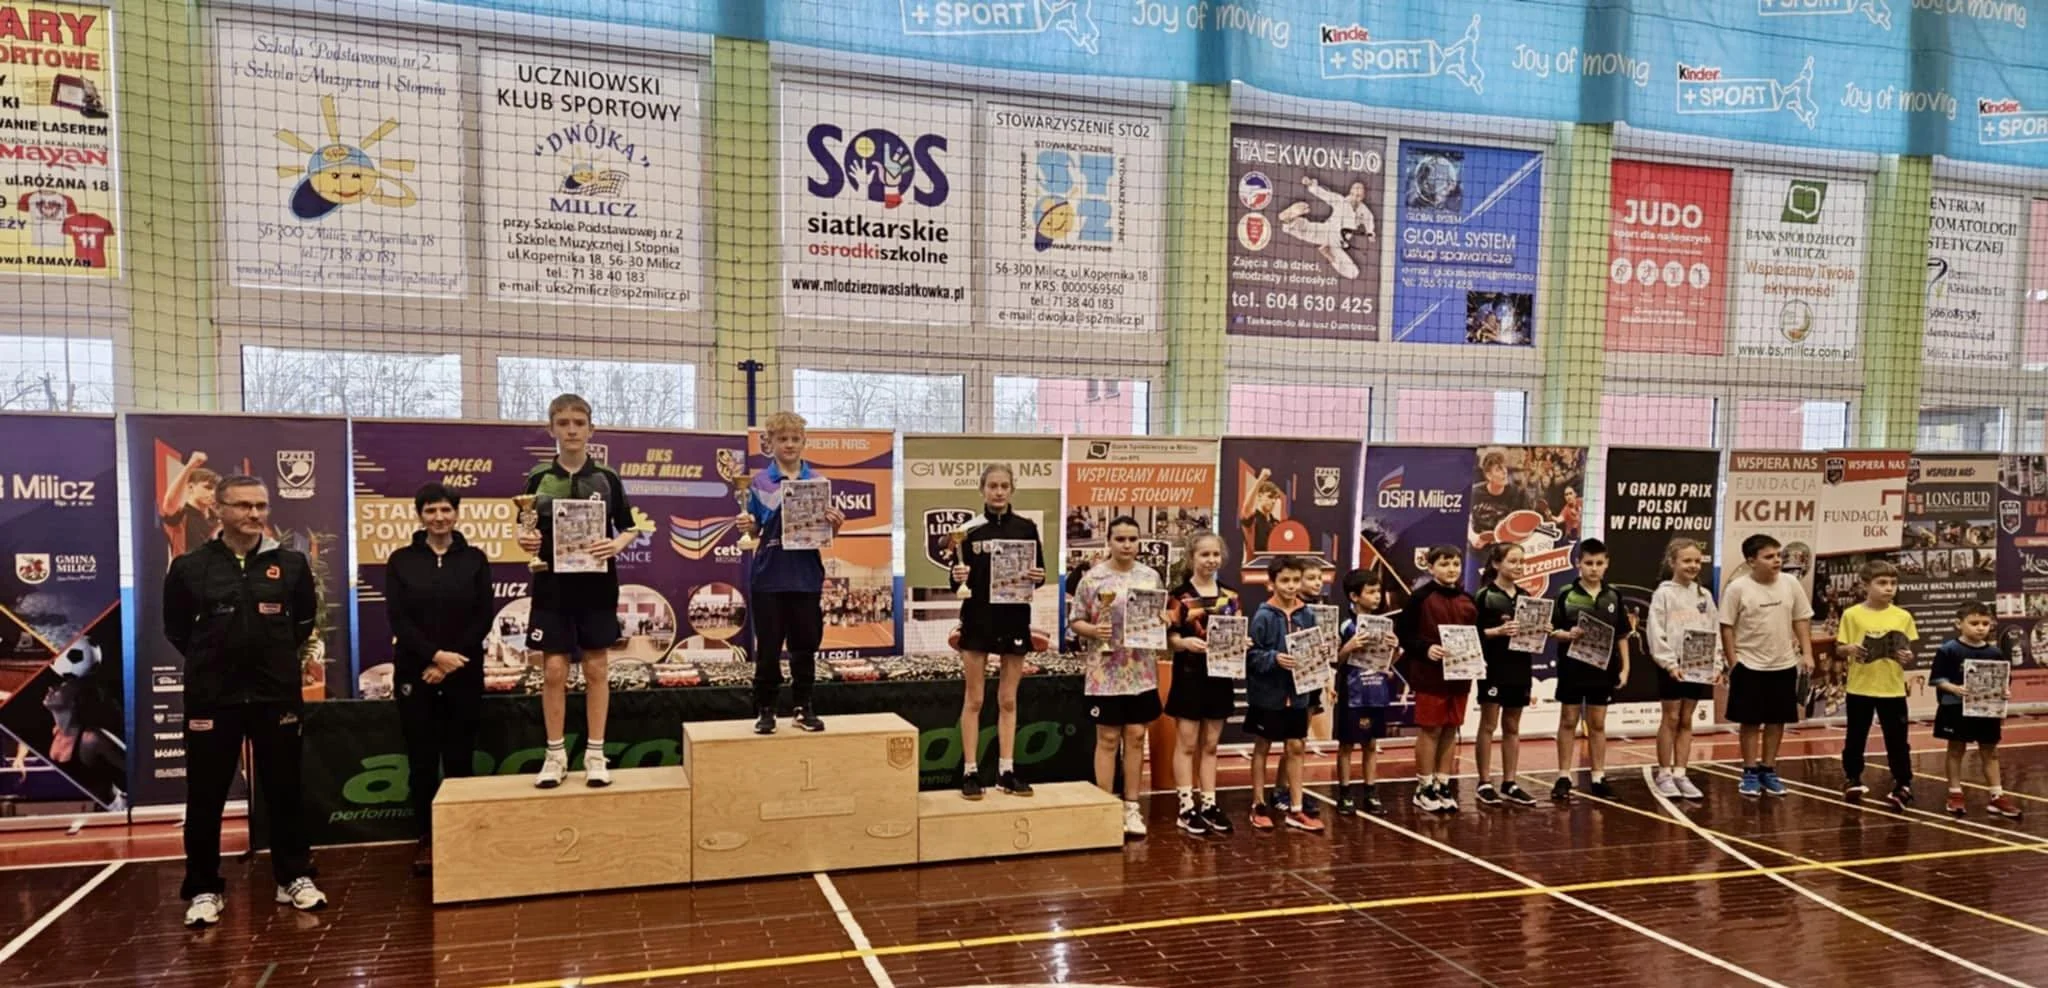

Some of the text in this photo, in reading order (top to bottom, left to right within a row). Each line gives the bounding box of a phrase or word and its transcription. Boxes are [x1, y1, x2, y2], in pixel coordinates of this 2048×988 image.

[935, 2, 1026, 27] SPORT
[1132, 1, 1290, 48] Joy of moving
[309, 40, 399, 68] Podstawowa
[1352, 47, 1424, 71] SPORT
[1511, 44, 1550, 78] Joy
[1555, 46, 1578, 73] of
[517, 64, 662, 96] UCZNIOWSKI
[496, 88, 682, 122] KLUB SPORTOWY
[1698, 86, 1767, 106] SPORT
[1840, 81, 1958, 121] Joy of moving
[43, 121, 108, 137] LASEREM
[995, 112, 1115, 137] STOWARZYSZENIE
[1033, 141, 1114, 154] STOWARZYSZENIE
[1232, 137, 1381, 173] TAEKWON-DO
[806, 123, 950, 208] SOS
[92, 181, 110, 195] 18
[549, 197, 638, 218] MILICZ
[1623, 198, 1704, 230] JUDO
[503, 217, 684, 241] przy Szkole Podstawowej nr 2
[807, 211, 950, 243] siatkarskie
[1746, 228, 1777, 242] BANK
[515, 232, 557, 248] Szkole
[560, 235, 625, 257] Muzycznej
[634, 240, 680, 256] Stopnia
[1403, 227, 1517, 250] GLOBAL SYSTEM
[646, 258, 681, 271] Milicz
[995, 262, 1033, 275] 56-300
[1272, 259, 1289, 269] dla
[1745, 260, 1816, 279] Wspieramy
[572, 267, 645, 283] 71 38 40 183
[1231, 291, 1374, 314] tel. 604 630 425
[427, 458, 493, 474] WSPIERA
[620, 462, 705, 479] LIDER MILICZ
[1020, 462, 1053, 477] NAS
[1737, 456, 1819, 471] WSPIERA NAS
[1848, 459, 1906, 472] WSPIERA NAS
[1077, 466, 1209, 484] WSPIERAMY MILICKI
[1735, 476, 1817, 494] FUNDACJA
[13, 474, 96, 500] Milicz
[1091, 487, 1196, 504] TENIS STOŁOWY!
[1617, 482, 1713, 499] V GRAND PRIX
[832, 490, 872, 511] ŃSKI
[1378, 489, 1463, 509] OSiR Milicz
[1637, 499, 1688, 515] POLSKI
[1926, 489, 1992, 507] LONG BUD
[936, 511, 966, 524] UKS
[1735, 499, 1816, 522] KGHM
[1824, 509, 1889, 529] FUNDACJA
[1609, 514, 1713, 531] W PING PONGU
[1863, 525, 1889, 539] BGK
[55, 554, 97, 565] GMINA
[713, 544, 743, 557] cets
[56, 563, 97, 574] MILICZ
[799, 757, 818, 792] 1
[1013, 816, 1034, 851] 3
[553, 825, 583, 865] 2
